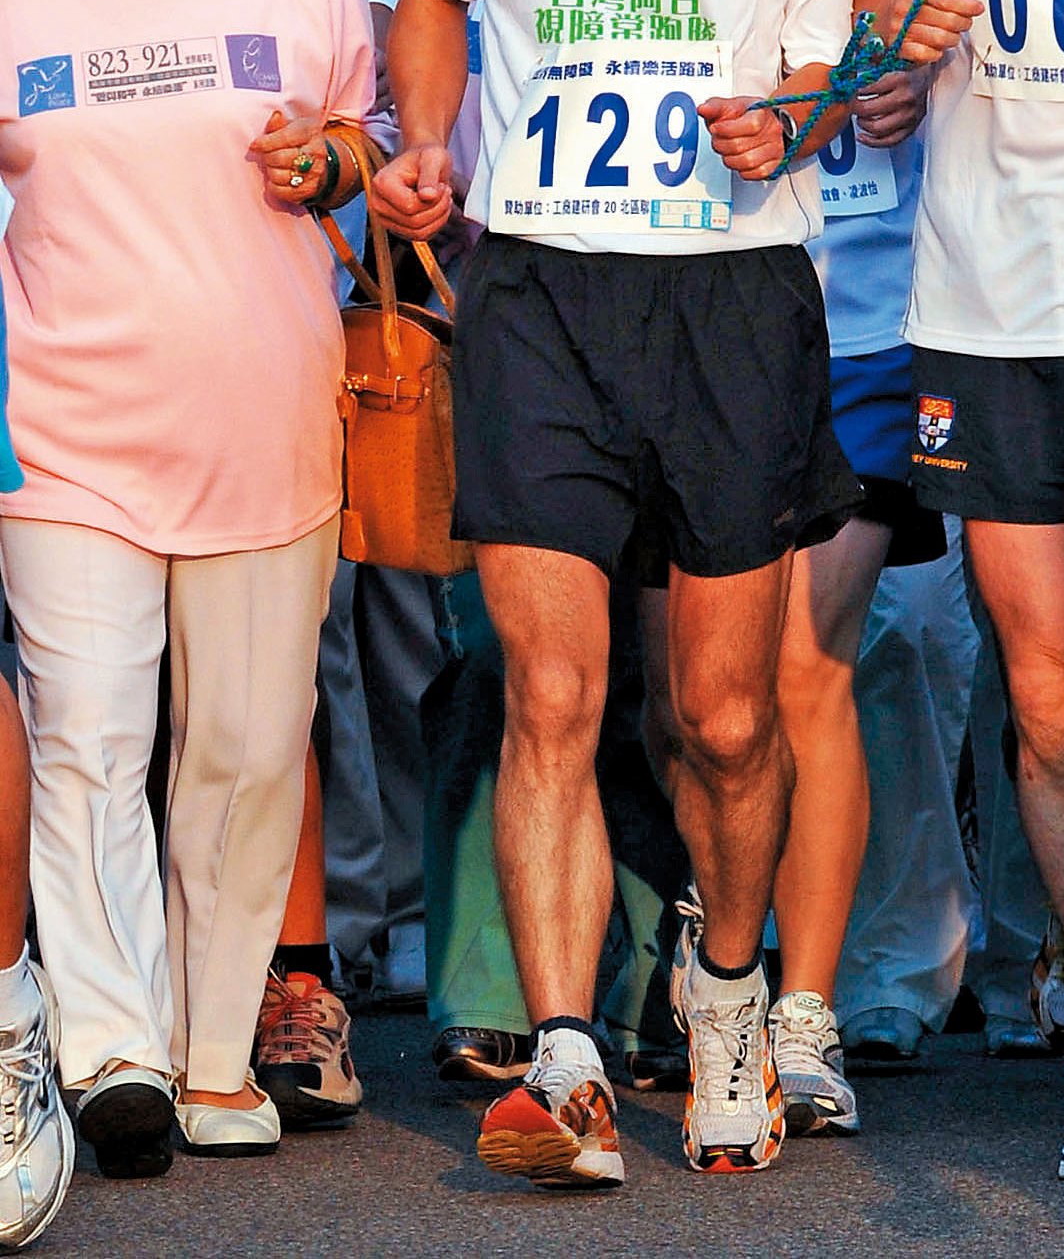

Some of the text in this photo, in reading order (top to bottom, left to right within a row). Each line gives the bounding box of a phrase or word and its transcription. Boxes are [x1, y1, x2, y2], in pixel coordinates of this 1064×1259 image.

[88, 42, 182, 77] 823-921
[605, 60, 714, 77] 永續樂活路跑
[526, 91, 699, 187] 129
[604, 201, 617, 214] 20
